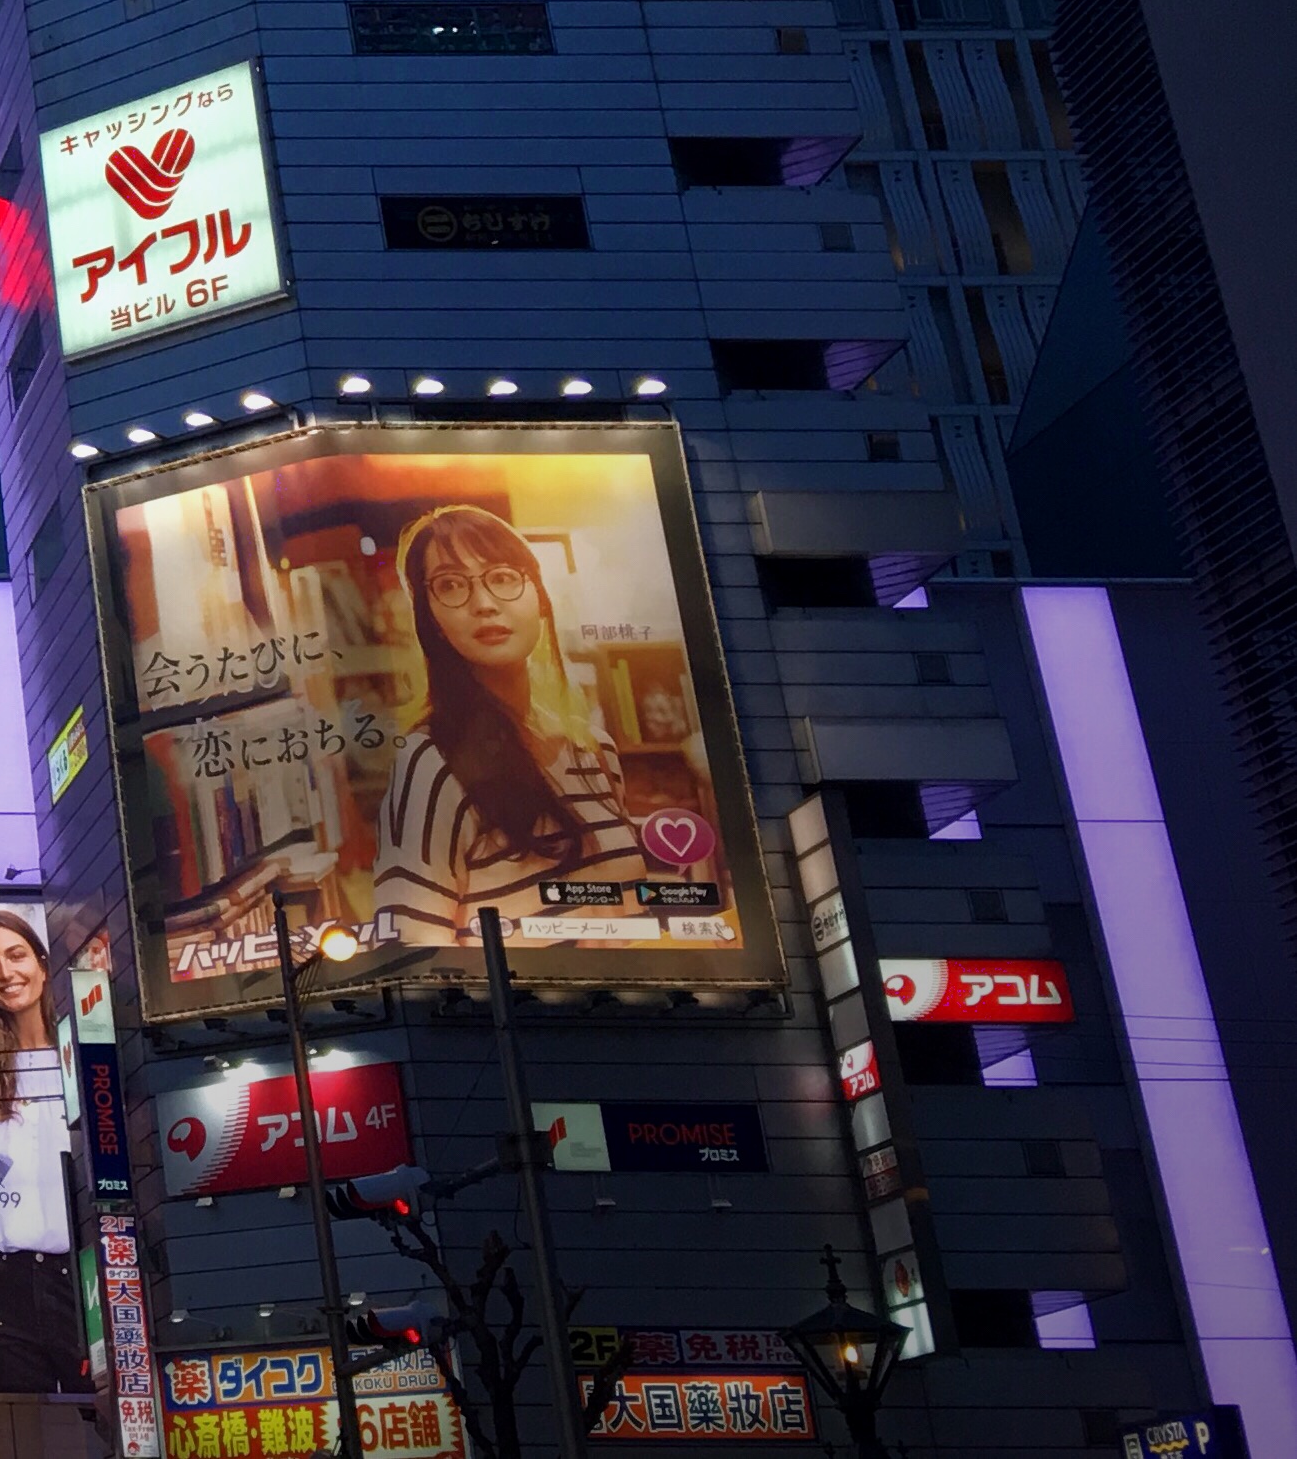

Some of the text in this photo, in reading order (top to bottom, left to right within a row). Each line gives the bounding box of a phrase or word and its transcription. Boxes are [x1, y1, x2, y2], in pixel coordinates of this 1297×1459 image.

[59, 82, 234, 156] キャッシングなら
[72, 208, 252, 303] アイフル
[185, 274, 230, 309] 6F
[142, 631, 343, 698] 会うたびに、
[193, 713, 408, 778] 恋におちる。
[565, 883, 612, 895] App Store
[659, 886, 689, 897] Google
[528, 921, 619, 935] ハッピーメール
[682, 921, 714, 935] 検索
[959, 973, 1063, 1006] アコム
[849, 1070, 876, 1096] アコム
[91, 1063, 119, 1155] PROMISE
[365, 1103, 396, 1130] 4F
[628, 1122, 737, 1145] PROMISE
[699, 1148, 739, 1161] プロミス
[97, 1178, 128, 1191] プロミス
[100, 1215, 134, 1233] 2F
[569, 1330, 617, 1362] 2F
[684, 1333, 762, 1362] 免税
[216, 1352, 324, 1400] ダイコク
[398, 1374, 439, 1387] DRUG
[120, 1400, 154, 1424] 免税
